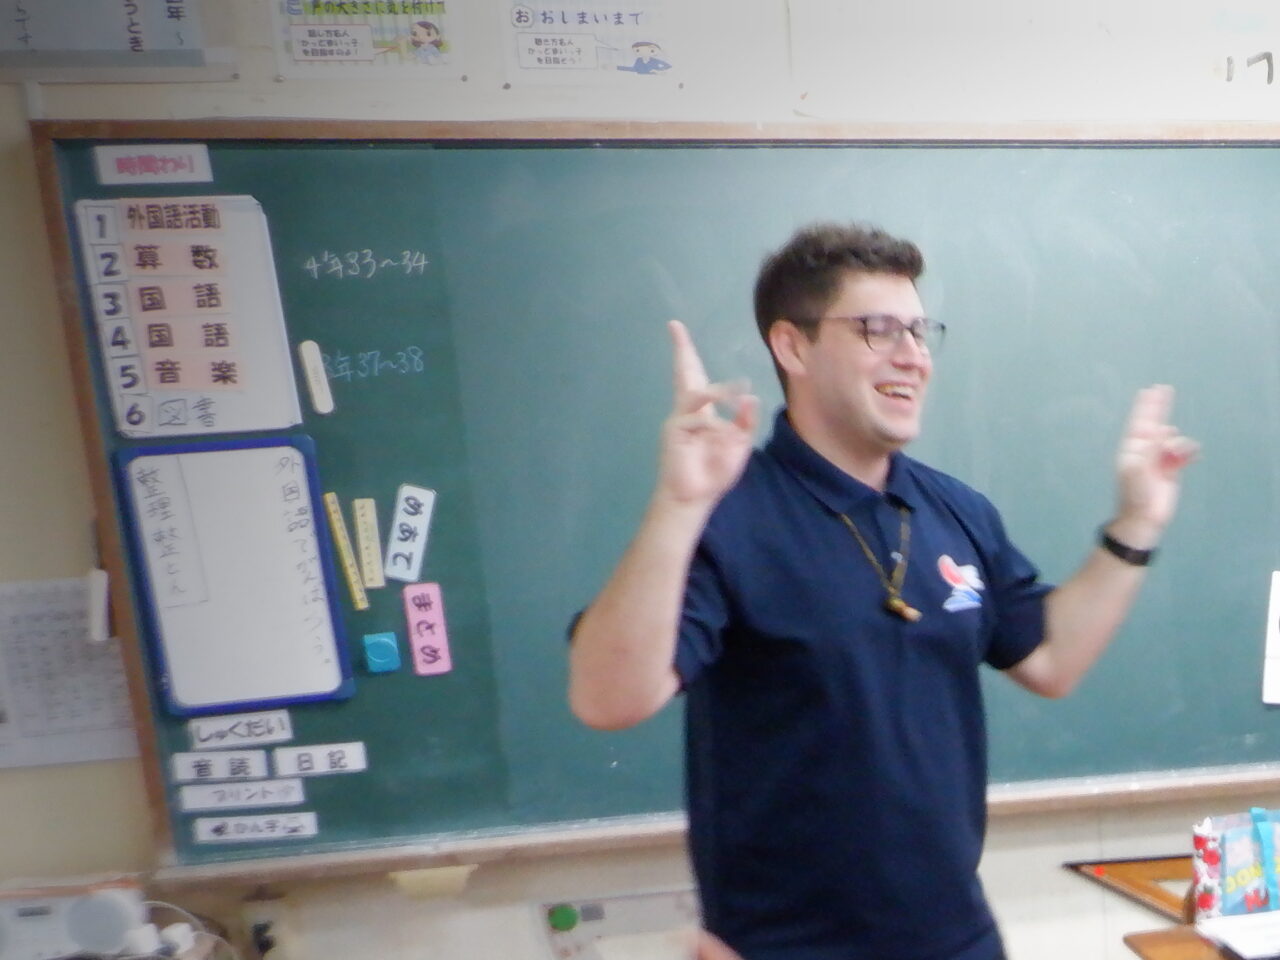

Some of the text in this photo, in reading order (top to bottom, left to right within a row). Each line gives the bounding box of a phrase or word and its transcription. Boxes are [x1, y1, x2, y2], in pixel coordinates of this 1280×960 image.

[96, 203, 221, 239] 1 外国語活動
[100, 243, 220, 277] 2 算数
[103, 282, 223, 316] 3 国語
[110, 321, 231, 350] 4 国語
[119, 357, 239, 389] 5 音楽
[125, 402, 147, 426] 6
[192, 757, 251, 778] 音読
[297, 749, 348, 772] 日記
